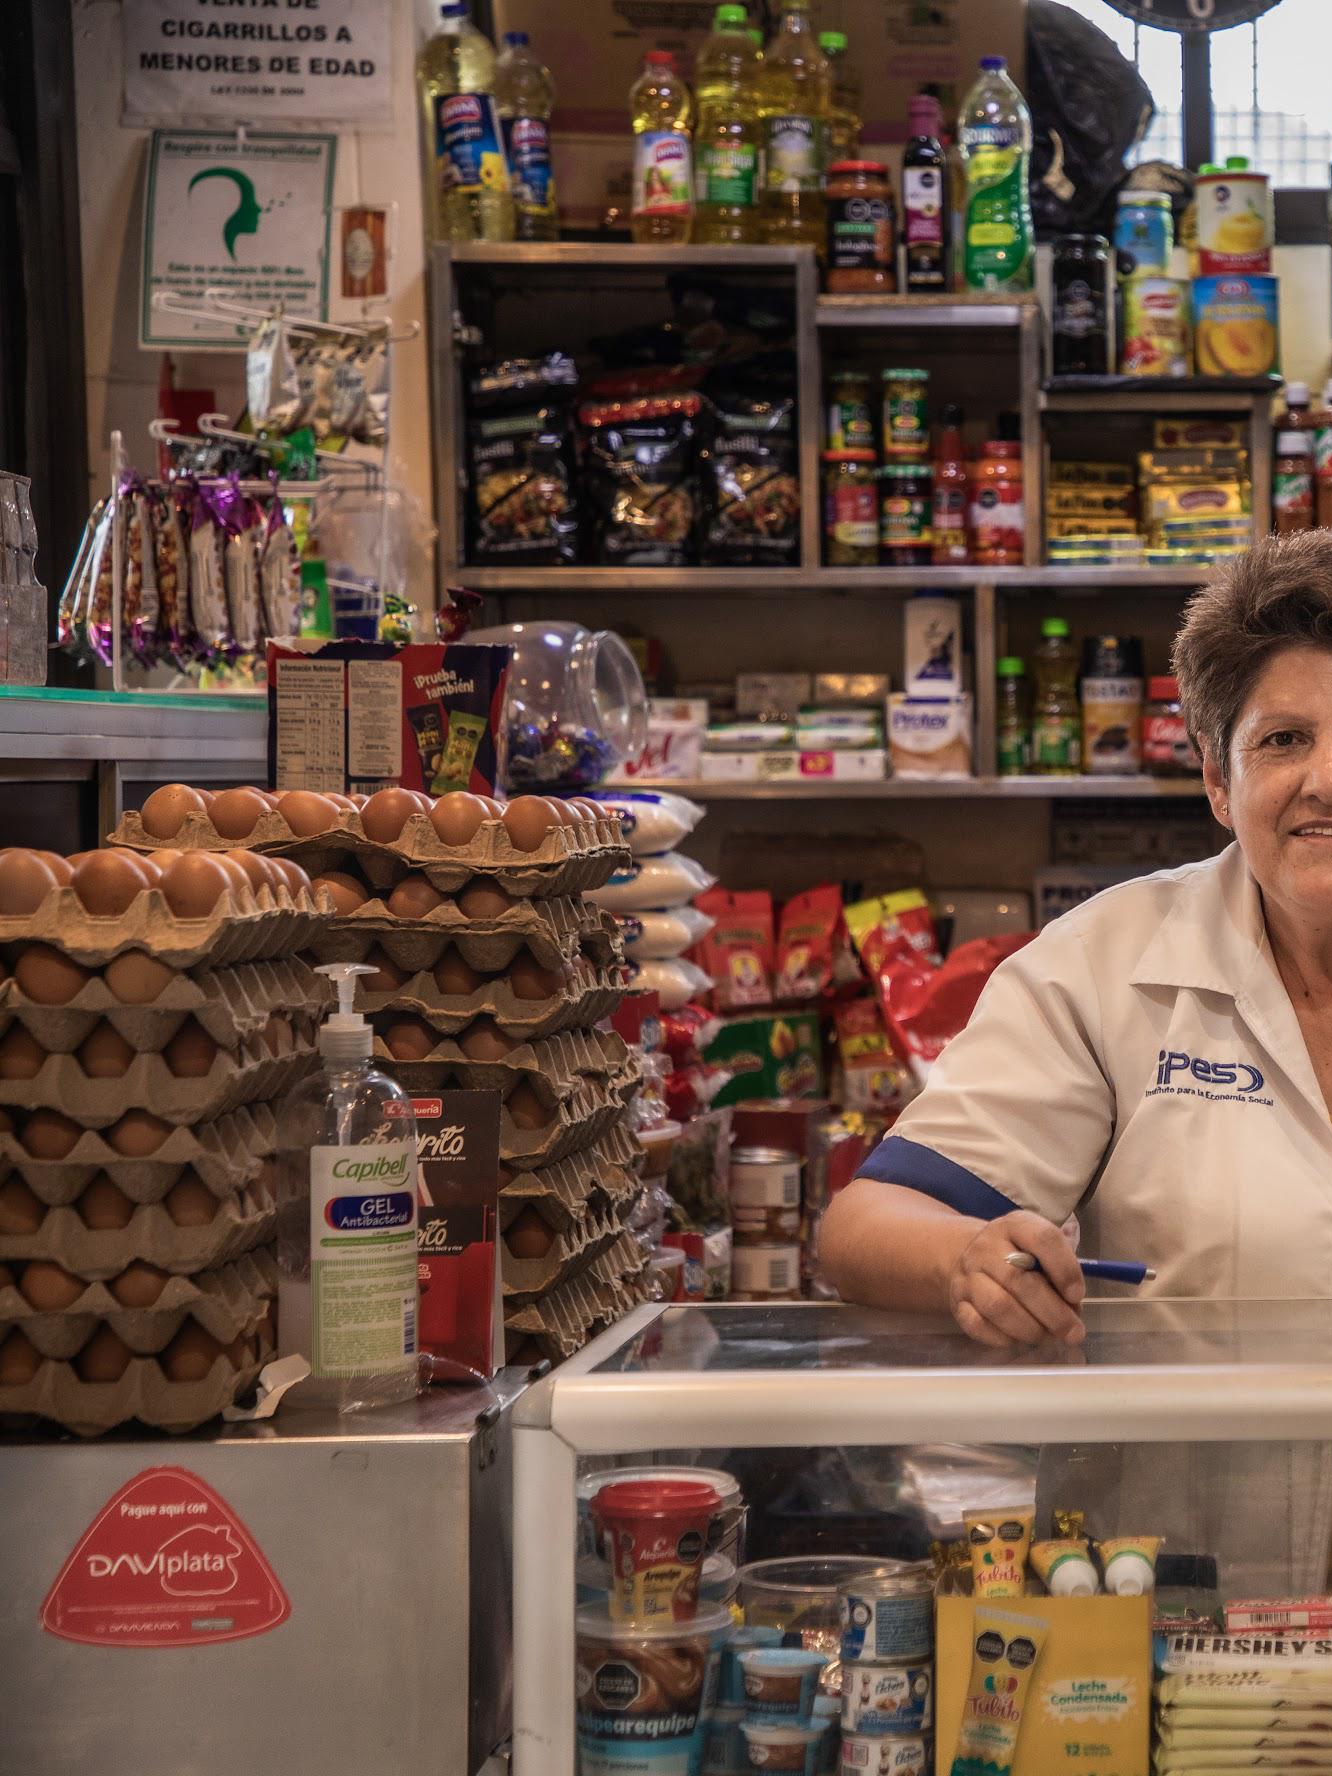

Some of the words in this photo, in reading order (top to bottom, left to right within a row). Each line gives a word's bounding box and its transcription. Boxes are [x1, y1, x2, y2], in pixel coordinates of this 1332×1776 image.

[161, 19, 327, 42] CIGARRILLOS
[335, 25, 353, 43] A
[139, 51, 261, 74] MENORES
[269, 57, 301, 74] DE
[309, 57, 376, 76] EDAD
[280, 663, 312, 673] Información
[313, 664, 342, 673] Nutricional
[413, 668, 457, 689] ¡Prueba
[426, 679, 475, 700] también!
[1145, 1086, 1175, 1097] Instituto
[1177, 1087, 1196, 1096] para
[1197, 1088, 1205, 1097] la
[1248, 1096, 1274, 1107] Social
[332, 1153, 409, 1183] Capibell
[360, 1198, 396, 1216] GEL
[340, 1211, 408, 1229] Antibacterial
[121, 1502, 157, 1519] Pague
[159, 1501, 186, 1518] aquí
[187, 1501, 208, 1513] con
[975, 1562, 1022, 1585] Tubito
[1071, 1680, 1107, 1692] Leche
[968, 1694, 1020, 1722] Tubito
[1050, 1692, 1128, 1706] Condensada
[613, 1713, 696, 1737] arequipe
